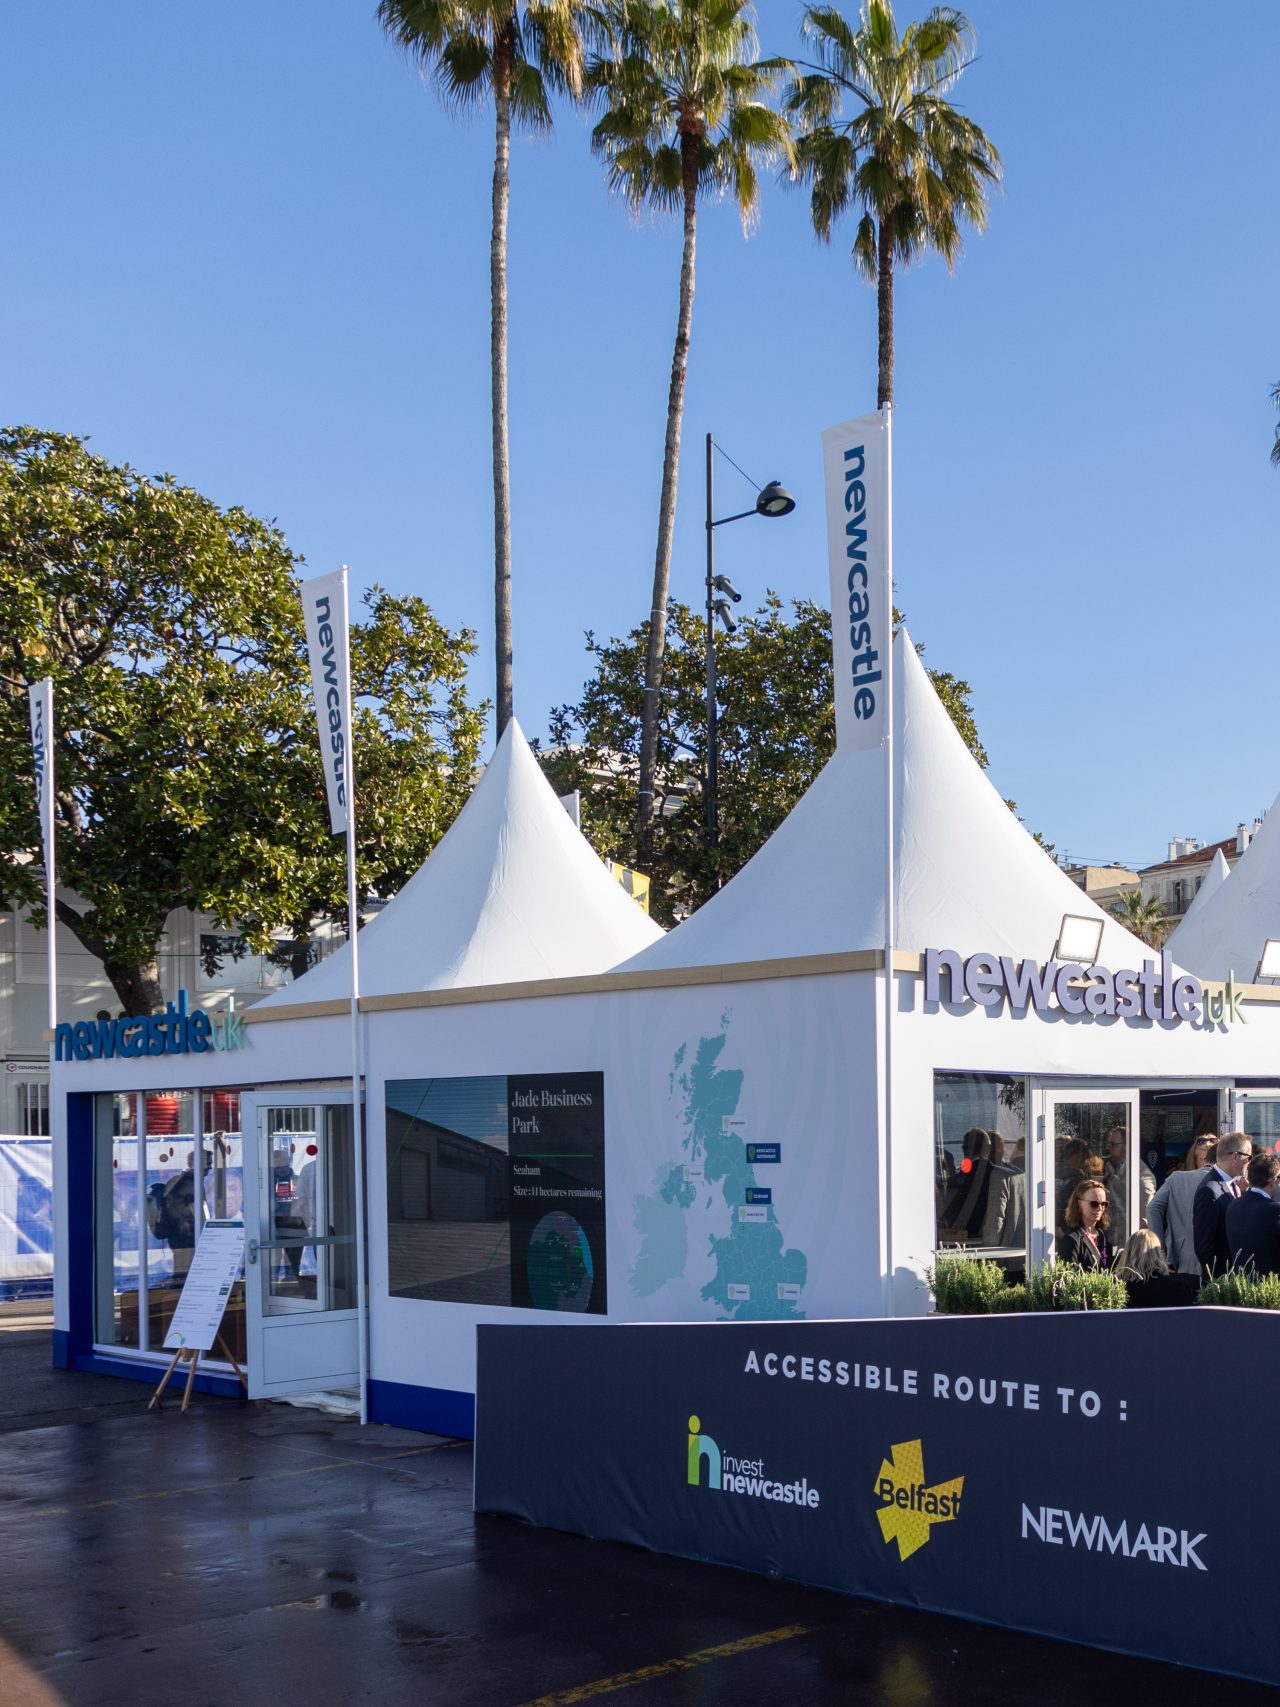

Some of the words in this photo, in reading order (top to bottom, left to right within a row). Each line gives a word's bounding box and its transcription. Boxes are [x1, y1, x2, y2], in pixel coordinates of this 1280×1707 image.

[843, 443, 883, 721] newcastle
[925, 948, 1201, 1023] newcastle
[1205, 968, 1249, 1025] uk
[54, 988, 212, 1062] newcastle
[211, 995, 245, 1052] uk
[511, 1089, 540, 1108] Jade
[541, 1089, 592, 1107] Business
[512, 1115, 541, 1134] Park
[513, 1164, 540, 1176] Seaham
[539, 1186, 568, 1197] hectares
[568, 1187, 603, 1201] remaining
[744, 1350, 918, 1395] ACCESSIBLE
[933, 1372, 1040, 1411] ROUTE
[1056, 1386, 1101, 1418] TO
[722, 1449, 765, 1478] invest
[722, 1472, 820, 1509] newcastle
[879, 1477, 961, 1519] Belfast
[1021, 1501, 1208, 1571] NEWMARK
